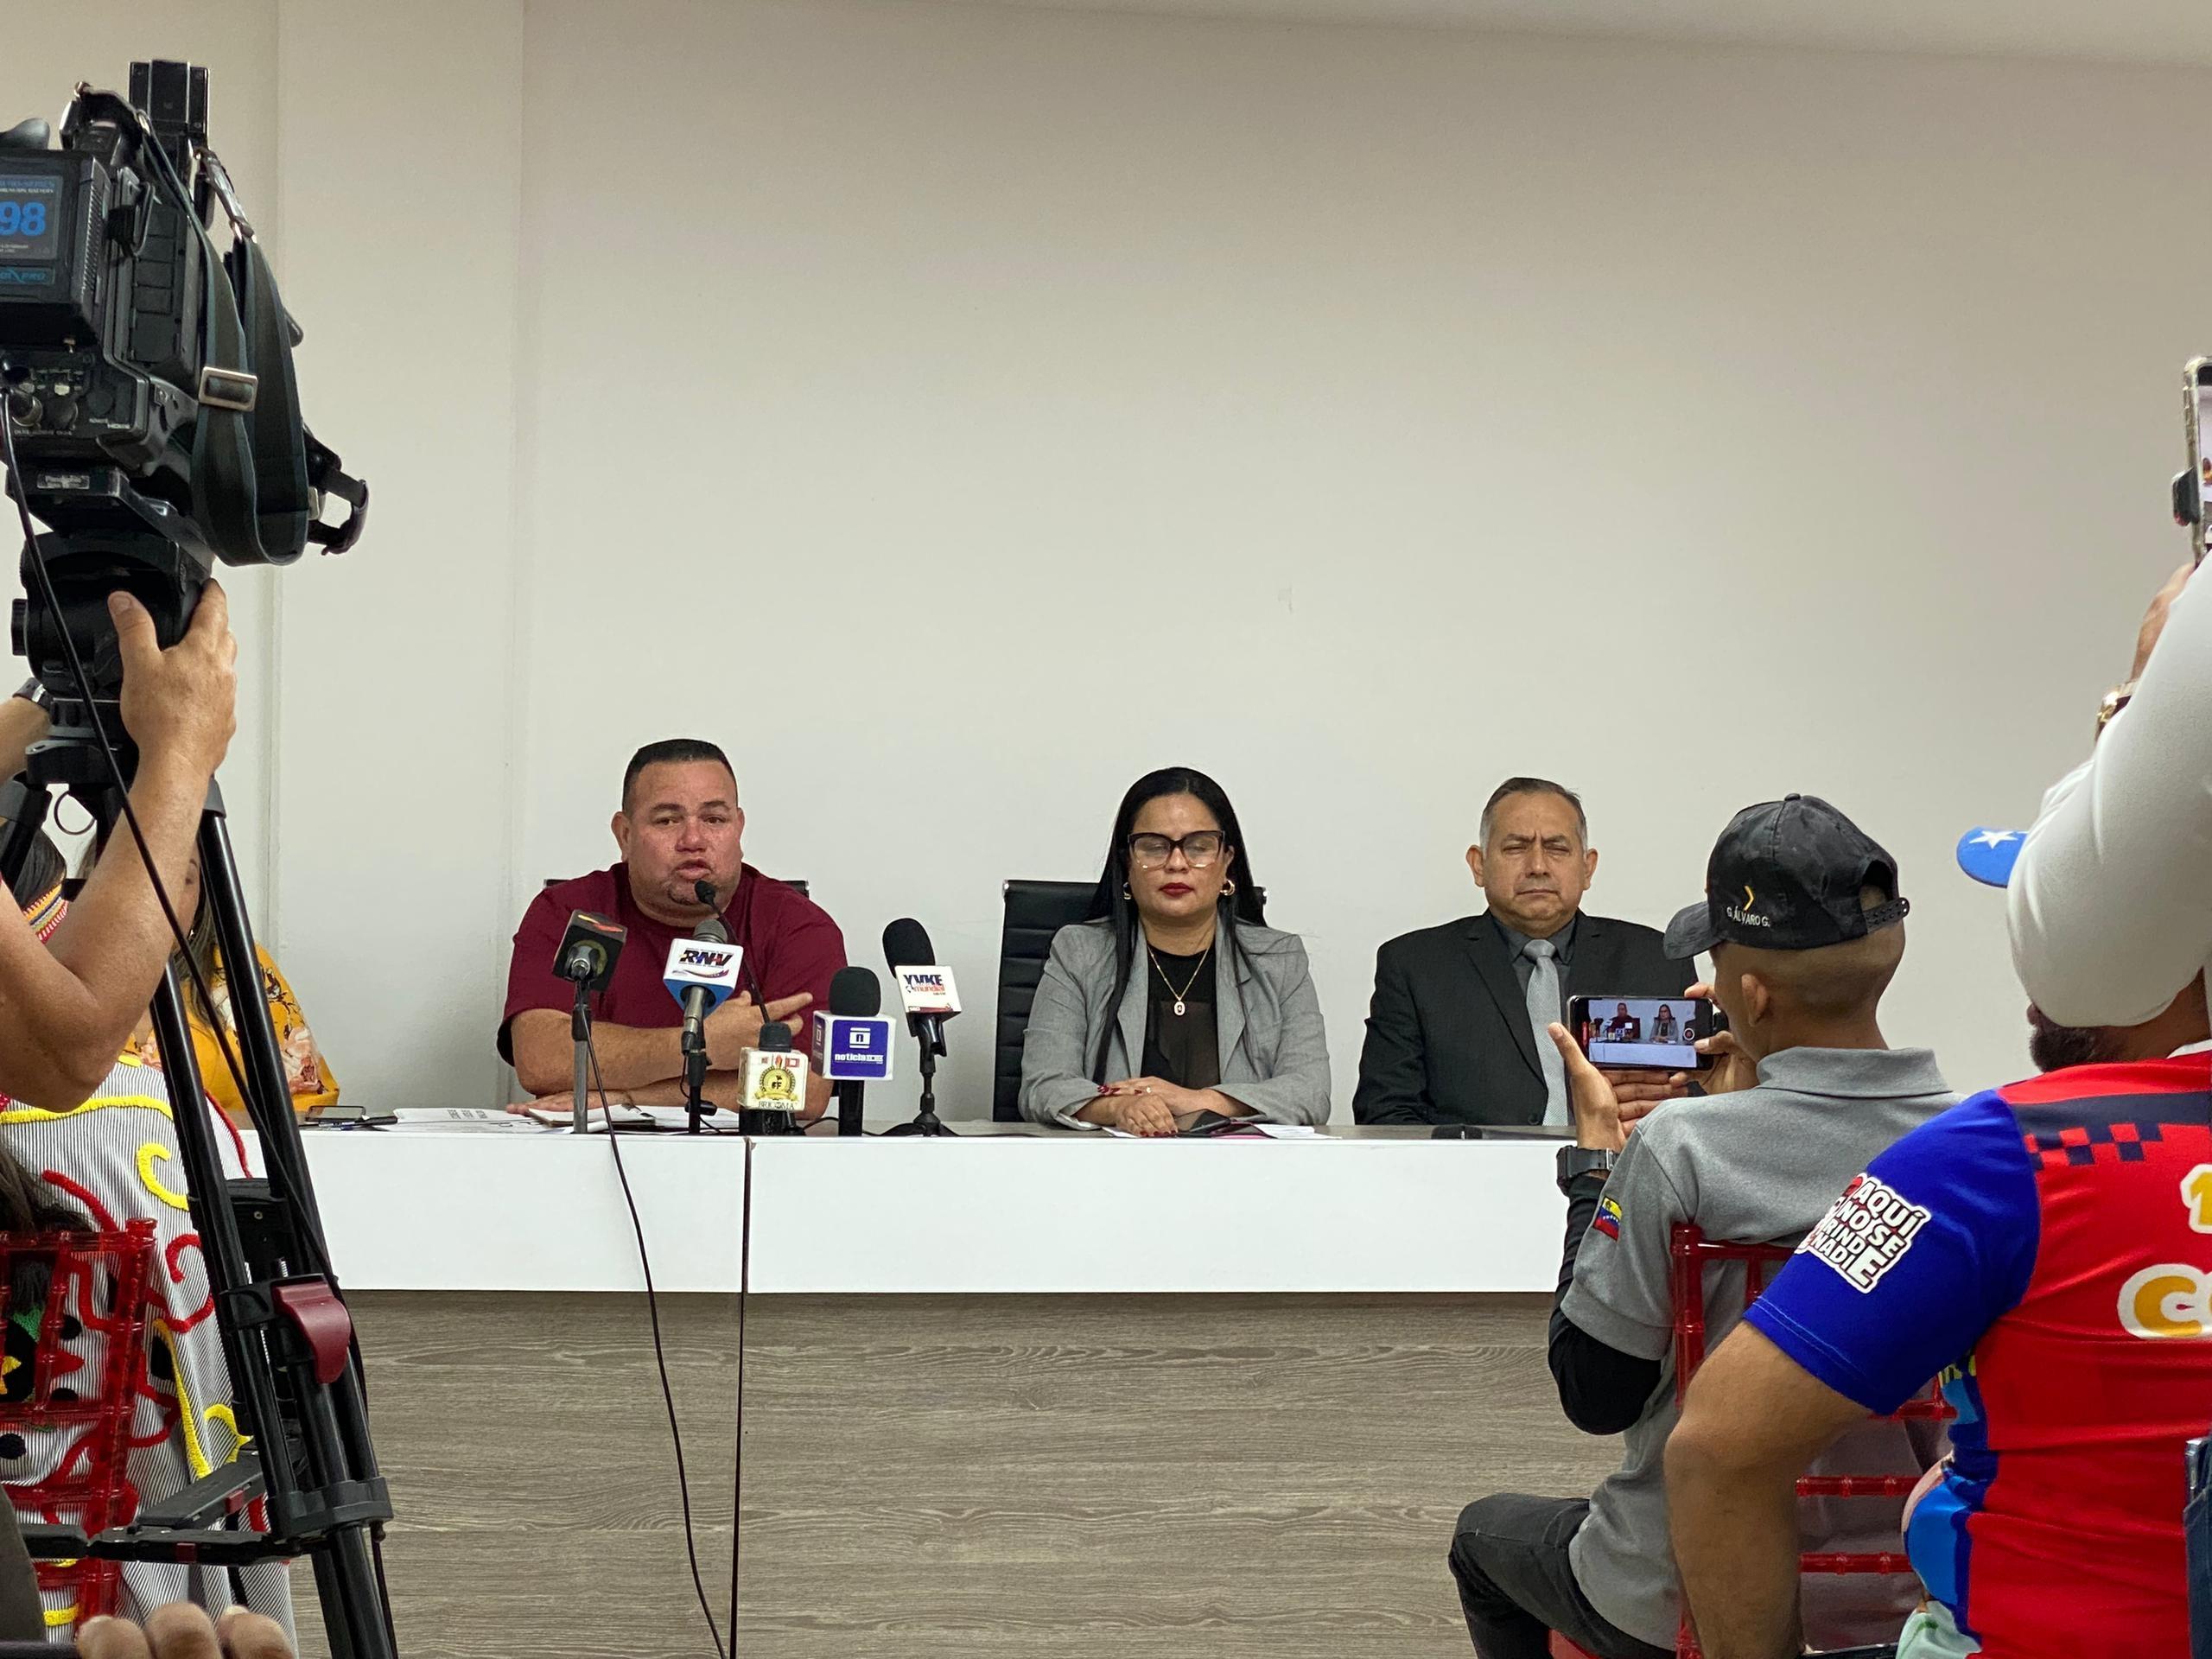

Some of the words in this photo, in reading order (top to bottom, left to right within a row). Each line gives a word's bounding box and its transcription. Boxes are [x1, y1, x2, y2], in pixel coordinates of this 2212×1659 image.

[679, 950, 734, 966] RNV
[1835, 1200, 1872, 1231] NO
[1866, 1223, 1906, 1257] SE
[1852, 1180, 1926, 1237] AQUÍ
